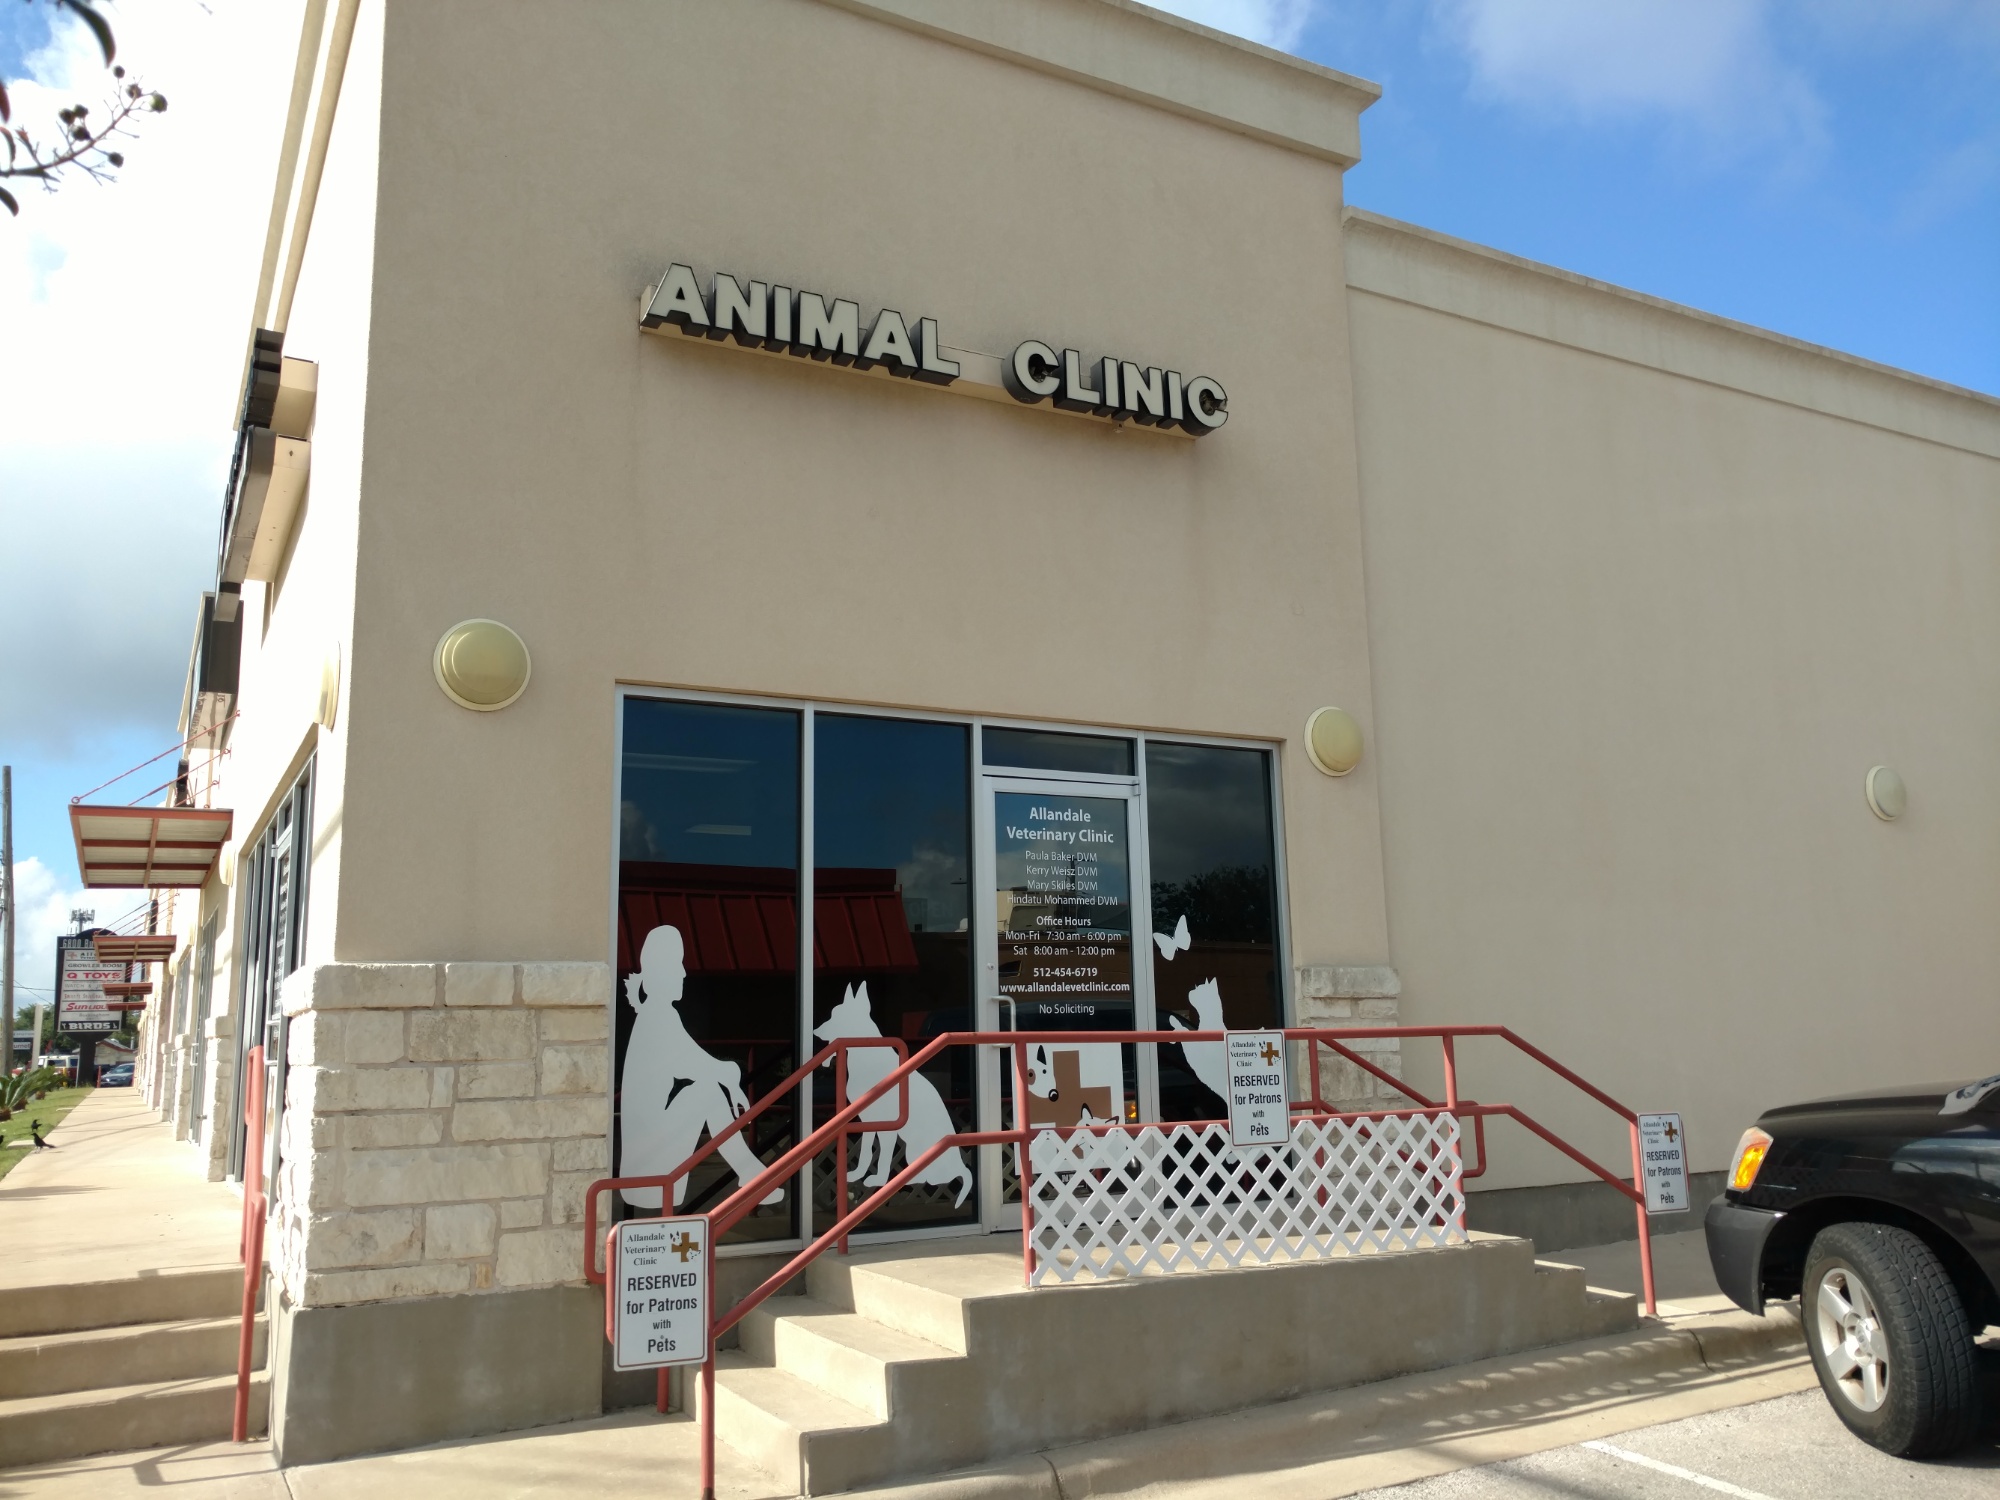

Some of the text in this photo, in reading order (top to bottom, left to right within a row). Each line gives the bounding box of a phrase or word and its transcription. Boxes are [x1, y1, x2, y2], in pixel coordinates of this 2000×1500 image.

[643, 262, 1229, 436] ANIMAL CLINIC
[1029, 806, 1091, 822] Allandale
[1006, 826, 1114, 844] Veterinary Clinic
[1025, 850, 1098, 862] Paula Baker DVM
[1026, 865, 1098, 877] Kerry Weisz DVM
[1027, 880, 1098, 891] Mary Skiles DVM
[1007, 894, 1118, 906] Hindatu Mohammed DVM
[1036, 916, 1091, 926] Office Hours
[1005, 931, 1040, 940] Mon-Fri
[1046, 931, 1065, 941] 7:30
[1066, 933, 1080, 941] am
[1087, 932, 1105, 941] 6:00
[1107, 933, 1121, 943] pm
[62, 939, 82, 948] 6800
[1013, 945, 1028, 955] Sat
[1033, 946, 1053, 955] 8:00
[1076, 946, 1099, 956] 12:00
[1101, 948, 1115, 958] pm
[1033, 967, 1098, 977] 512-454-6719
[1000, 982, 1130, 993] www.allandalevetclinic.com
[1039, 1004, 1095, 1016] No Soliciting
[69, 1022, 111, 1030] BIRDS
[1230, 1051, 1258, 1059] Veterinary
[1234, 1075, 1280, 1087] RESERVED
[1235, 1093, 1282, 1105] for Patrons
[1252, 1110, 1265, 1118] with
[1250, 1125, 1269, 1136] Pets
[1646, 1149, 1680, 1161] RESERVED
[1647, 1166, 1682, 1177] for Patrons
[1660, 1193, 1675, 1204] Pets
[626, 1232, 666, 1243] Allandale
[624, 1245, 667, 1255] Veterinary
[633, 1257, 658, 1266] Clinic
[627, 1272, 697, 1292] RESERVED
[626, 1298, 697, 1315] for Patrons
[652, 1319, 671, 1330] with
[647, 1338, 676, 1354] Pets
